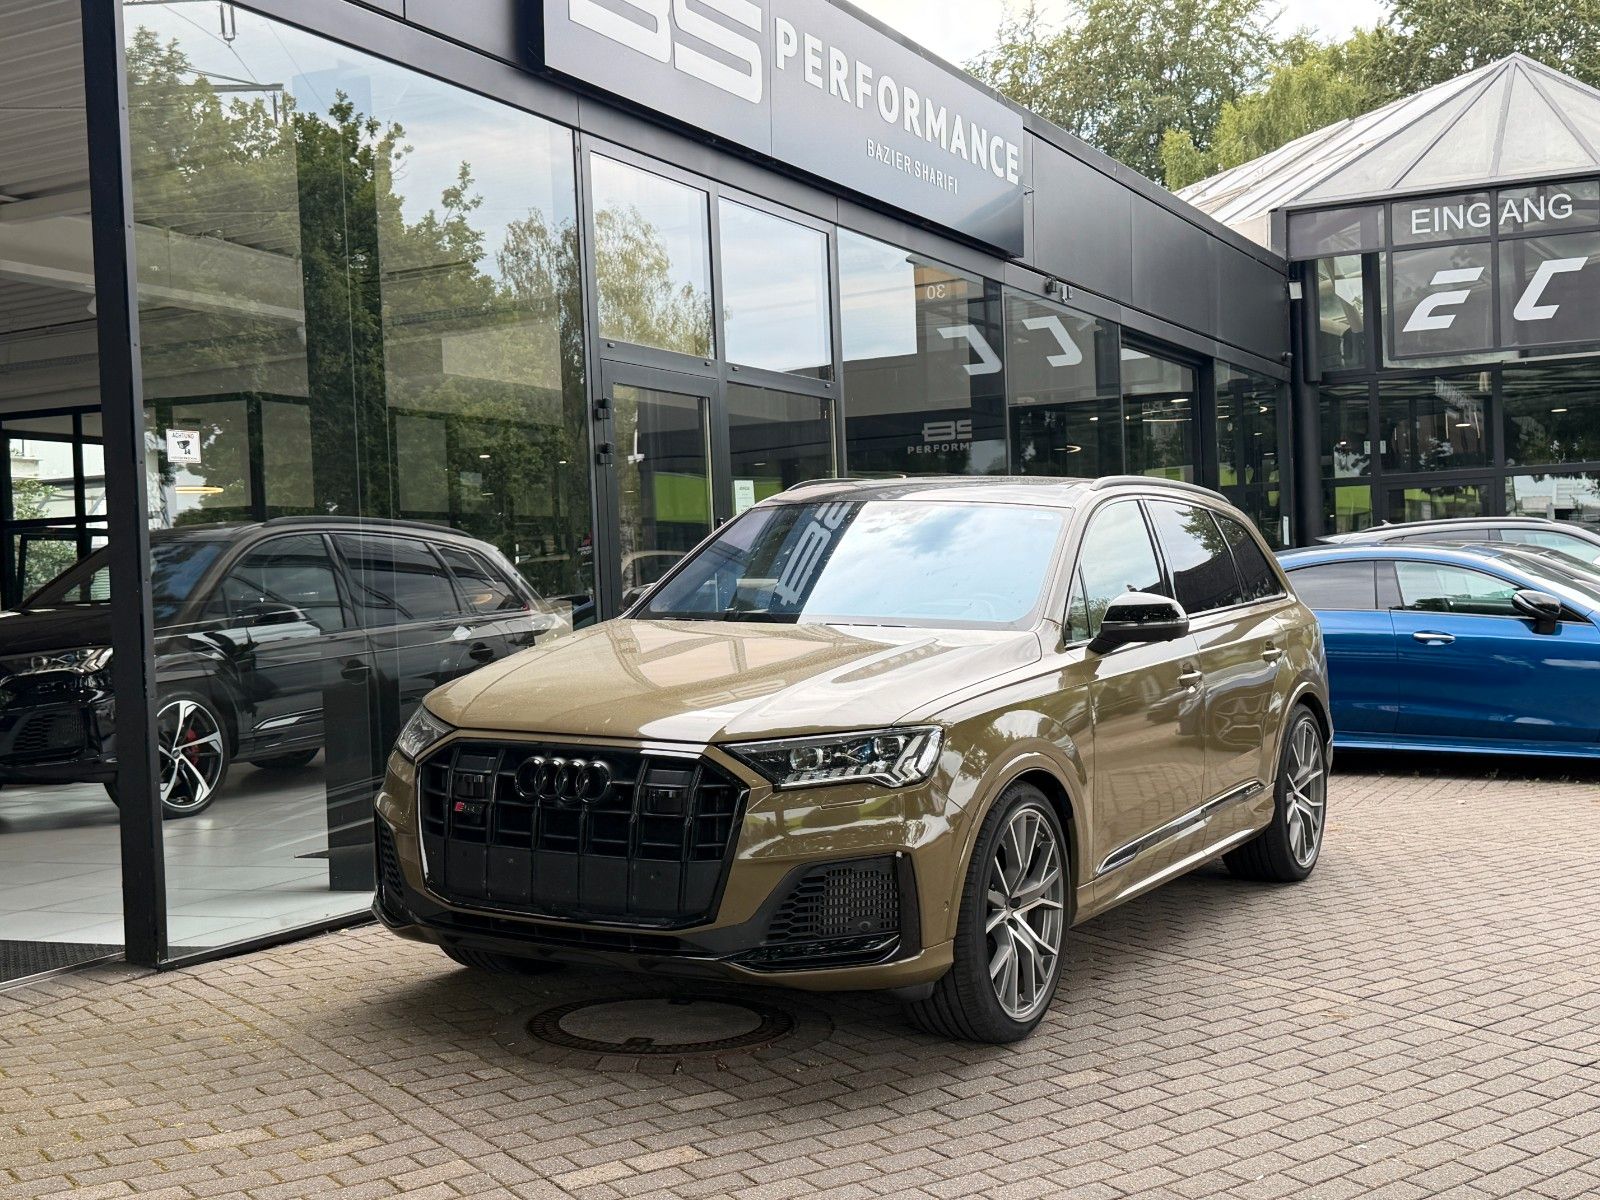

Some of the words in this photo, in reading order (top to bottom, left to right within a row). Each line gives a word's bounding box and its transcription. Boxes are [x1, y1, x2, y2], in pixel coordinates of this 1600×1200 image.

[775, 17, 1020, 185] PERFORMANCE
[867, 138, 912, 174] BAZIER
[914, 160, 958, 194] SHARIFI
[1411, 193, 1573, 235] EINGANG
[907, 443, 973, 455] PERFORM
